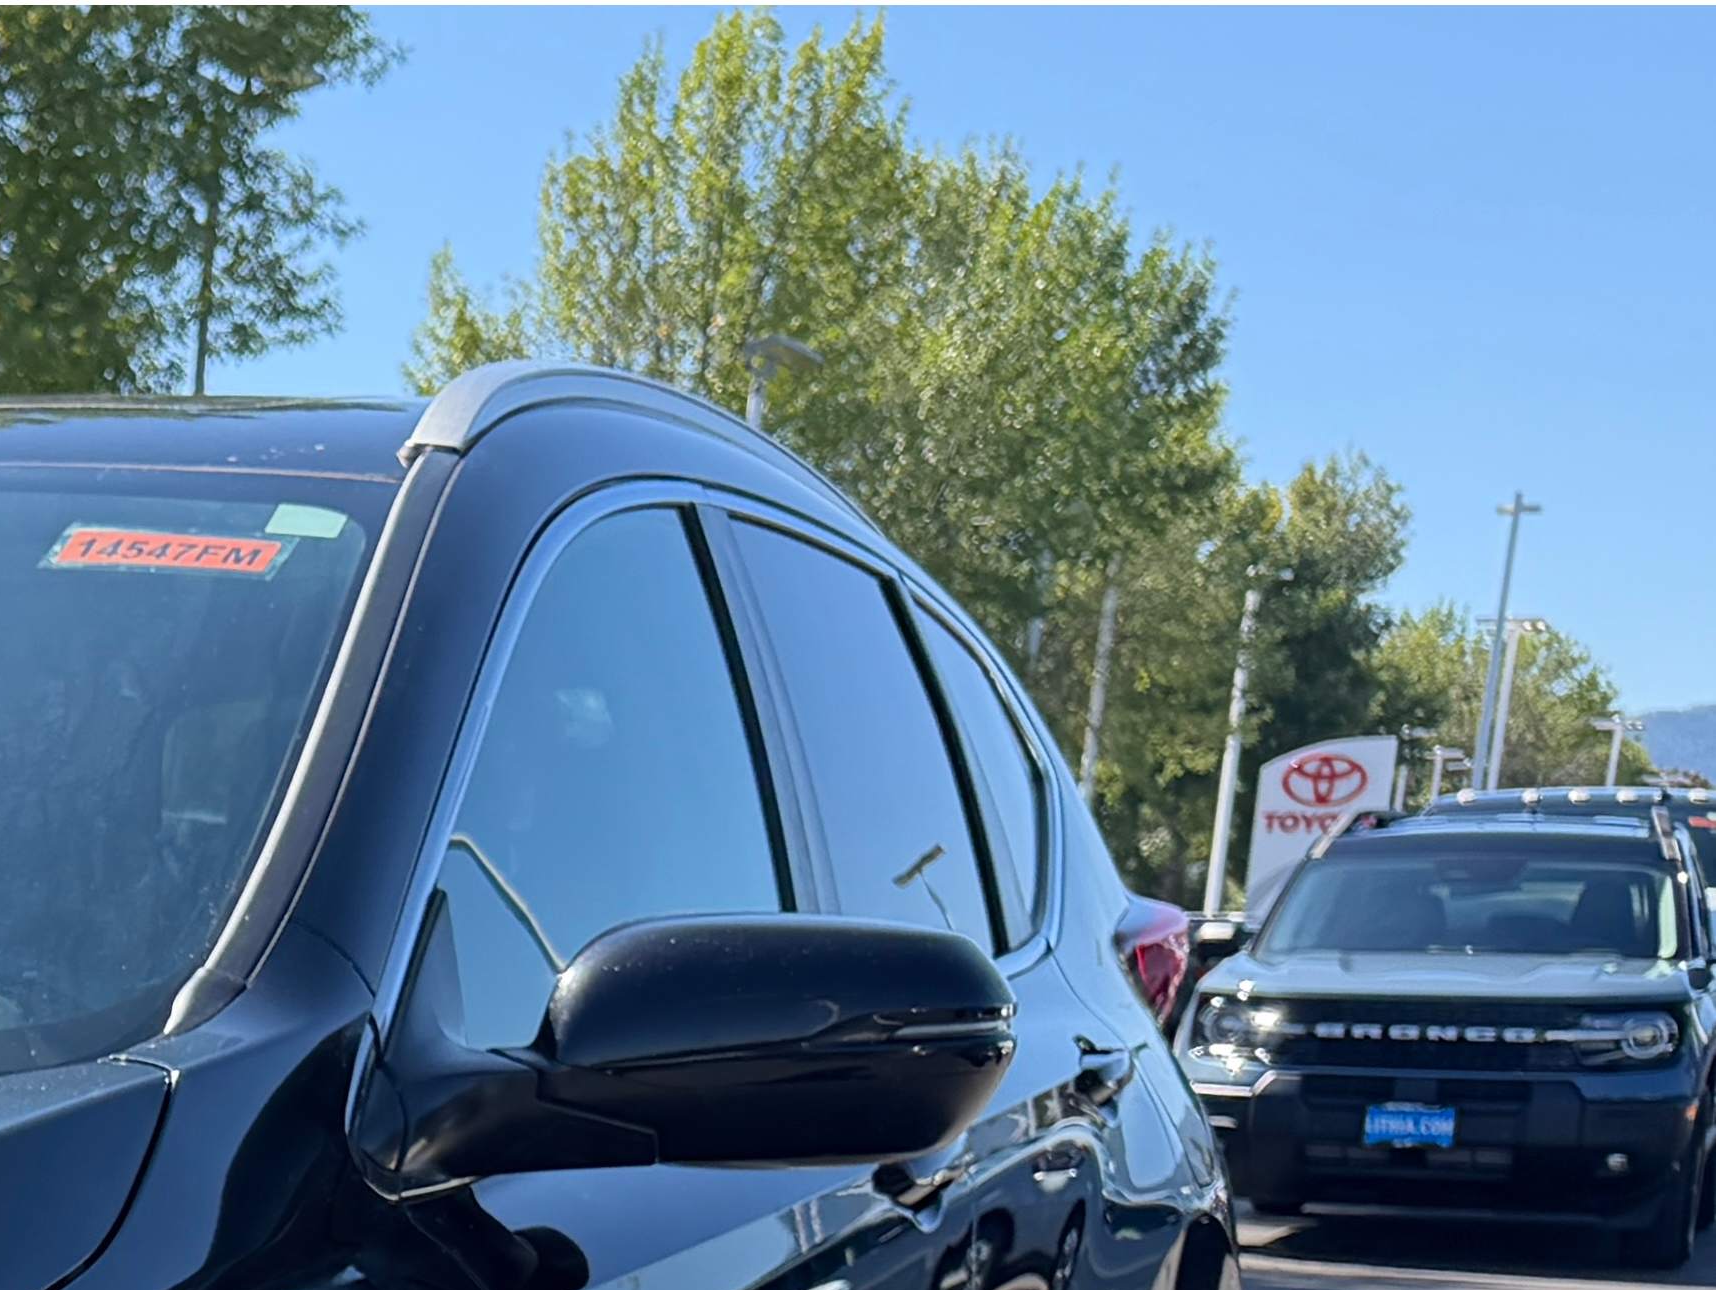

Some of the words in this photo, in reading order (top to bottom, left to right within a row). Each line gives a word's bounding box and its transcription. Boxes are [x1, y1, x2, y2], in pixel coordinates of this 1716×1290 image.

[79, 537, 263, 567] 14547FM
[1263, 811, 1349, 835] TOYO
[1314, 1022, 1537, 1043] BRONCO
